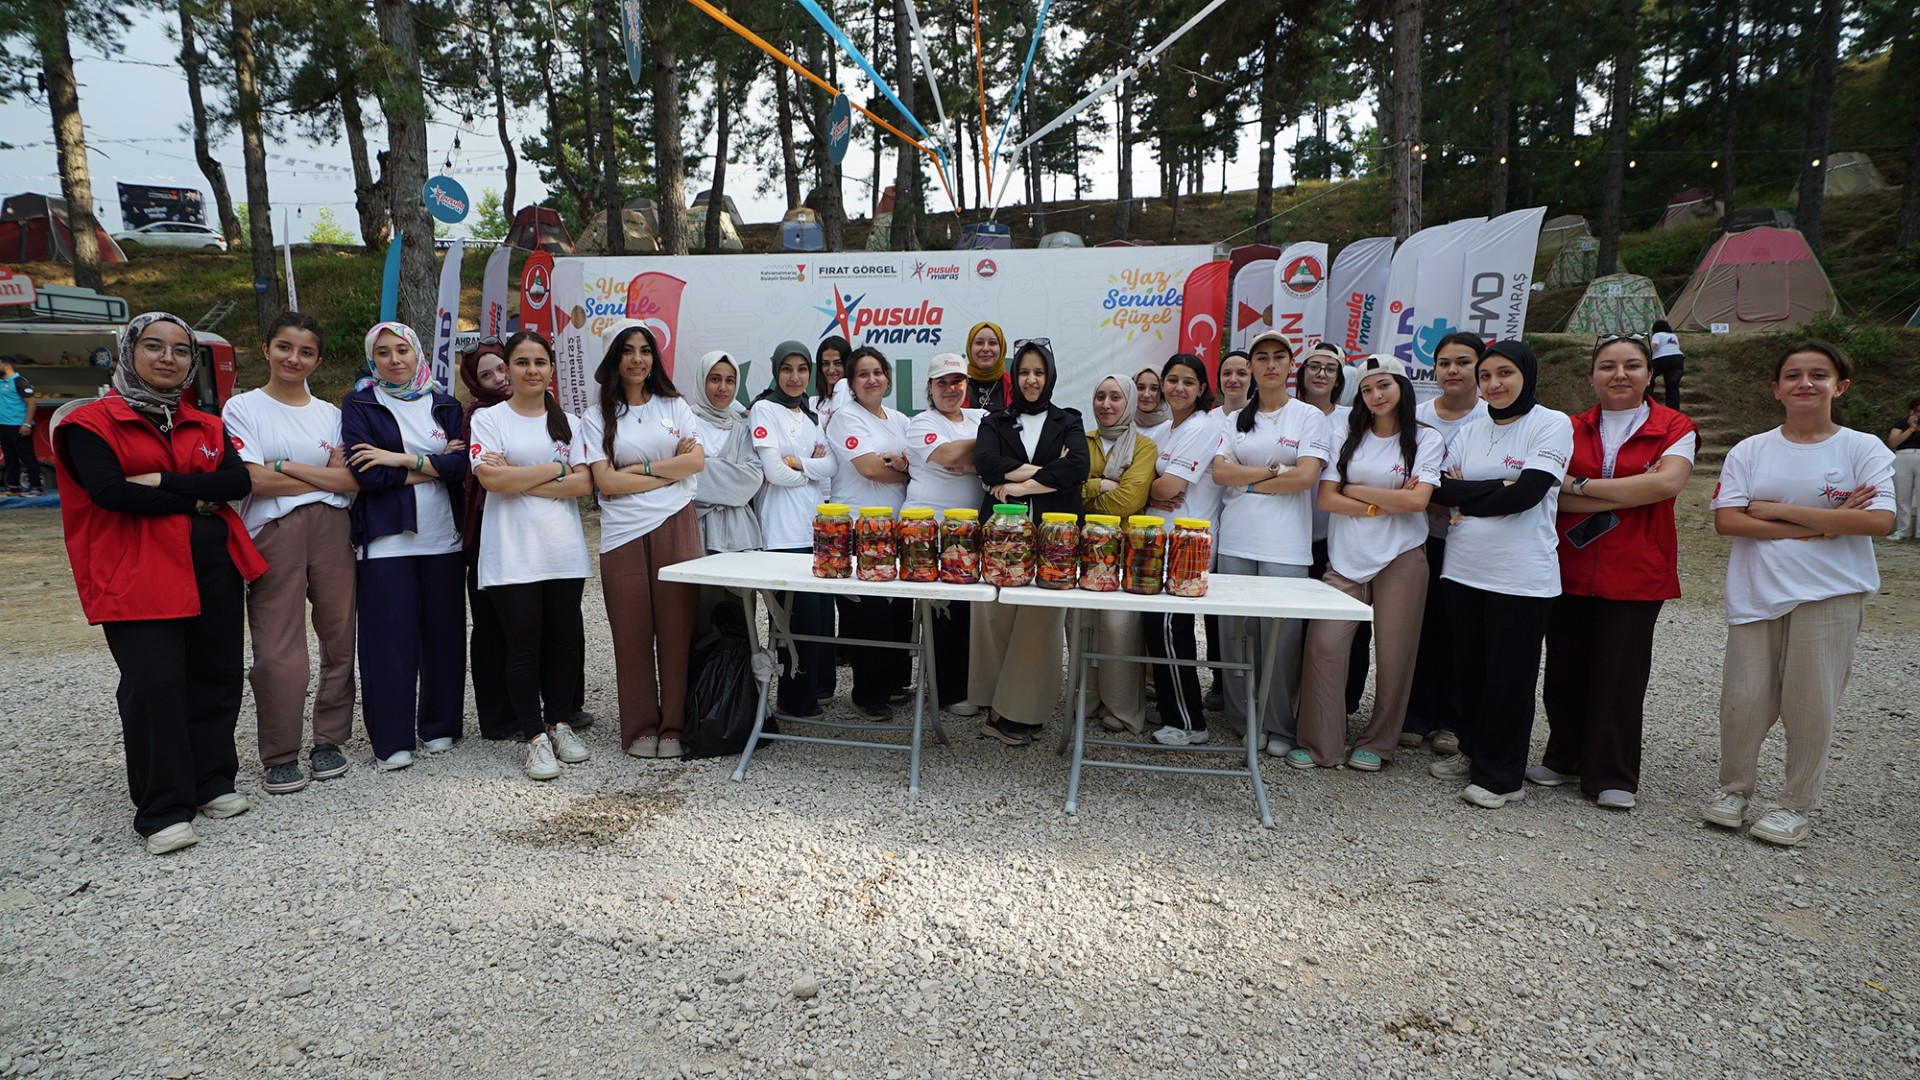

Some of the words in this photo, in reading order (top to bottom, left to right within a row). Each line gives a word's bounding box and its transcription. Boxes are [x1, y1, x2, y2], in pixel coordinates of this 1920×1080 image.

[818, 266, 850, 275] FIRAT
[852, 264, 898, 274] GÖRGEL
[926, 264, 960, 277] pusula
[1121, 267, 1172, 293] Yaz
[1103, 288, 1183, 310] Seninle
[853, 300, 944, 336] pusula
[1112, 307, 1172, 333] Güzel
[1345, 291, 1364, 353] pusula
[436, 311, 452, 388] FAD
[865, 327, 942, 346] maraş
